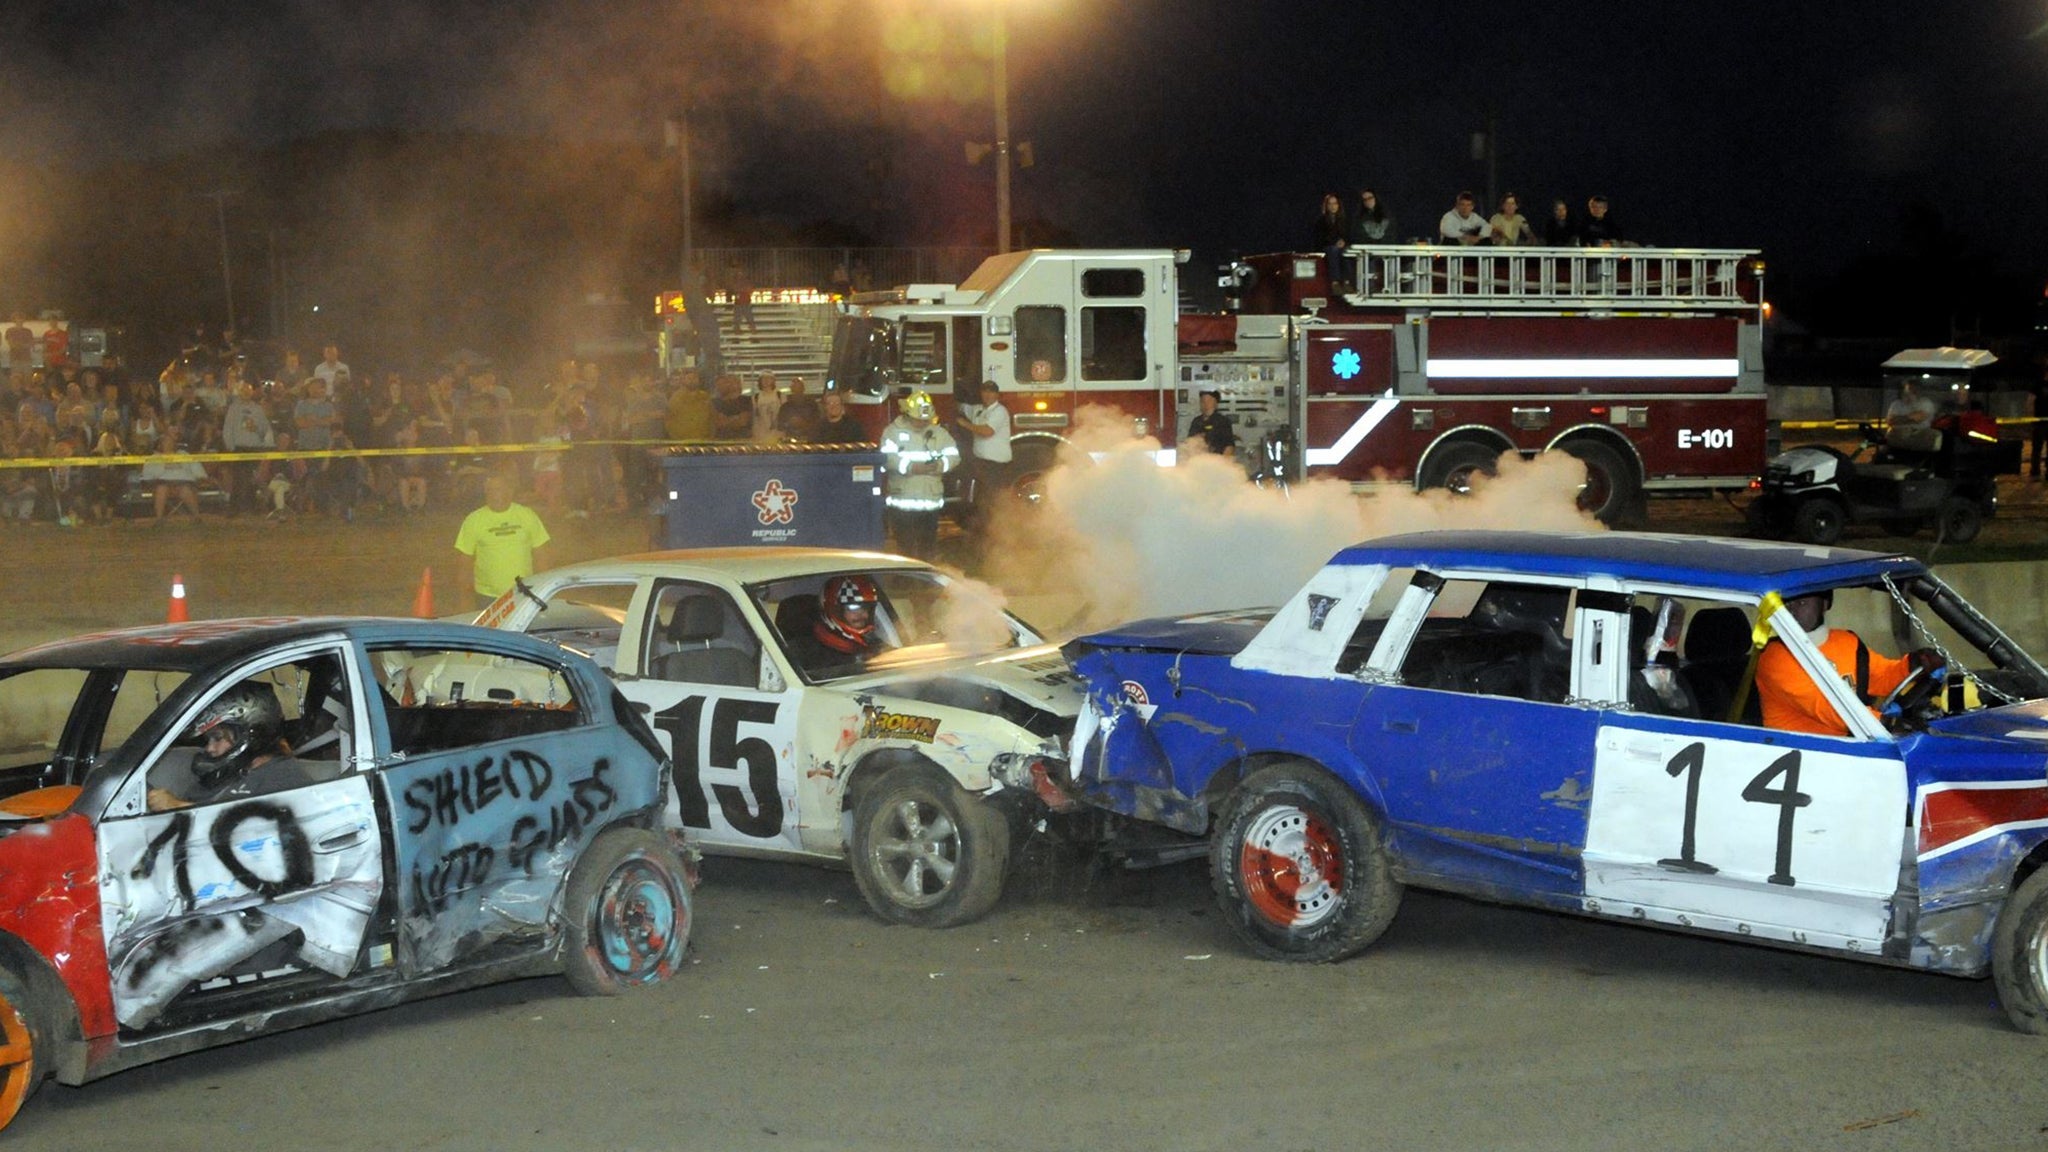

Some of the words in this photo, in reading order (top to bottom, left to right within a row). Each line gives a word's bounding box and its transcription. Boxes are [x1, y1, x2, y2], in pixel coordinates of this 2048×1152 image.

[1678, 429, 1733, 448] E-101
[752, 529, 797, 537] REPUBLIC
[653, 695, 784, 839] 15
[1657, 742, 1813, 887] 14
[130, 801, 315, 912] 10
[410, 842, 494, 921] AUTO
